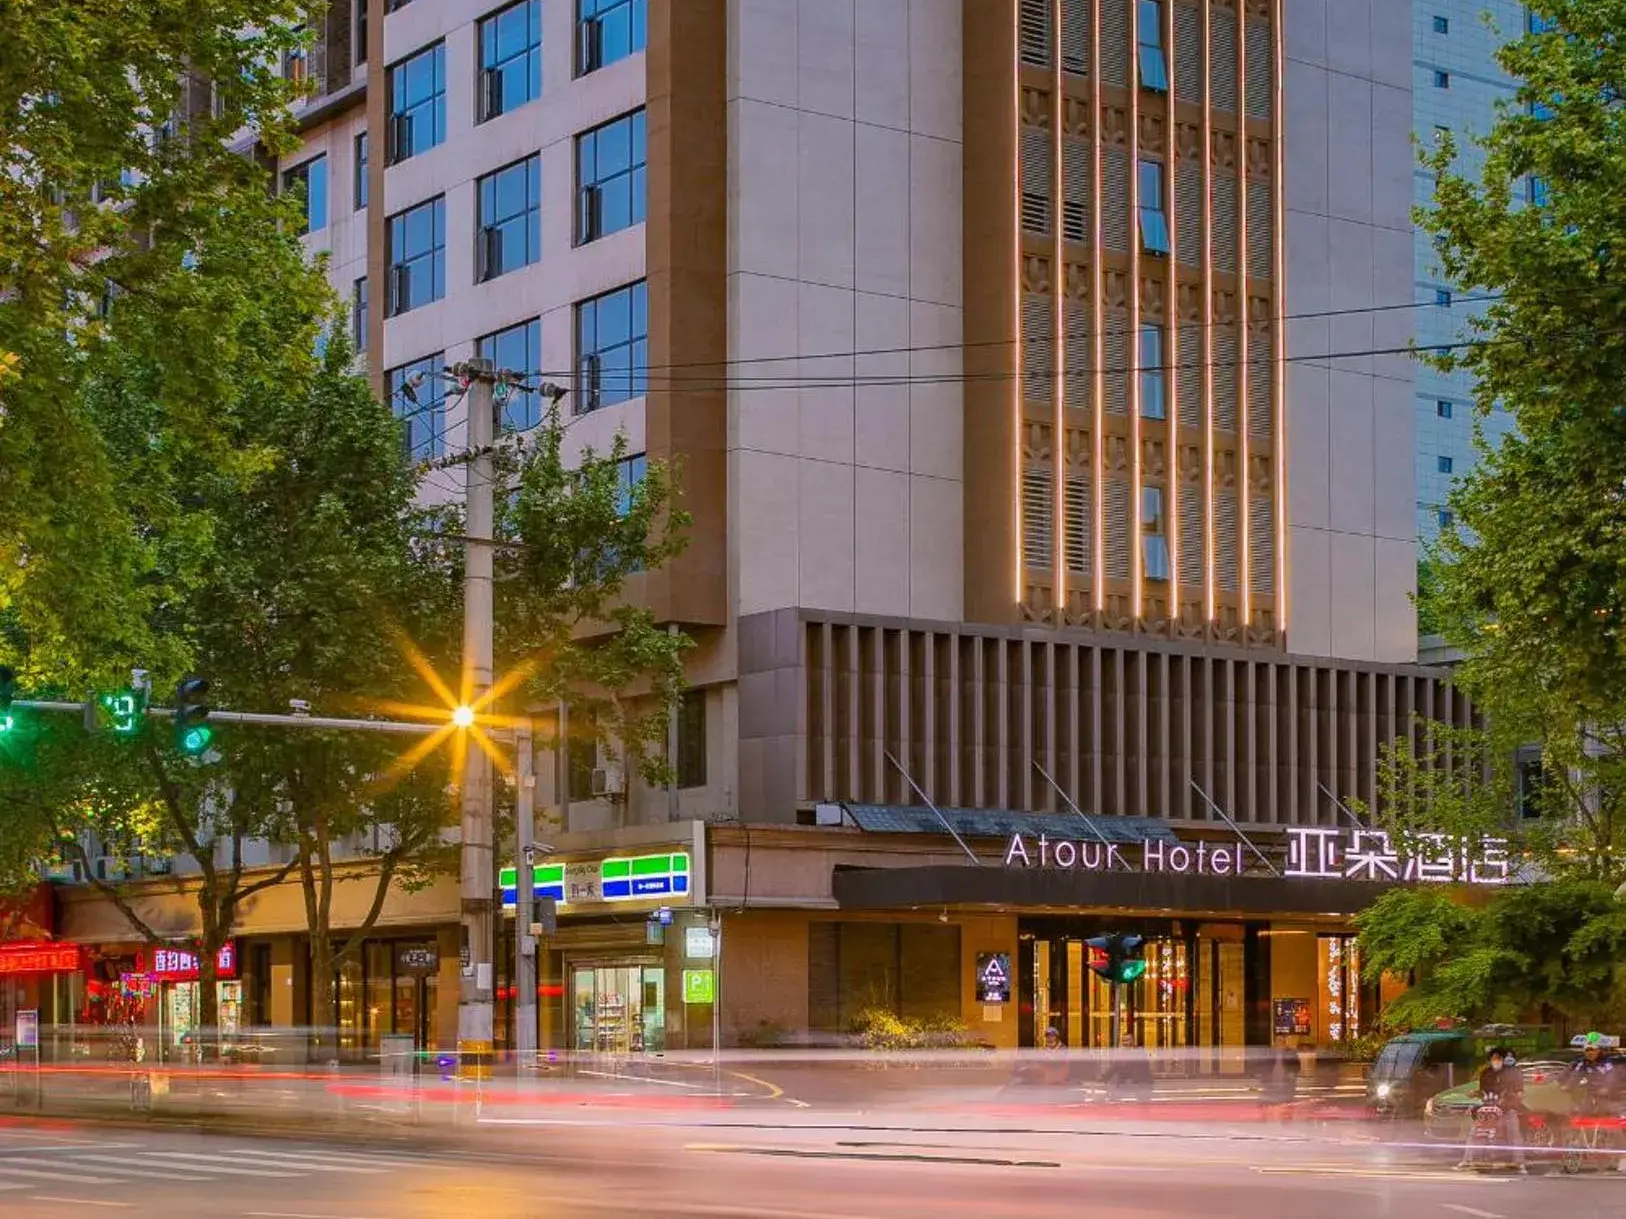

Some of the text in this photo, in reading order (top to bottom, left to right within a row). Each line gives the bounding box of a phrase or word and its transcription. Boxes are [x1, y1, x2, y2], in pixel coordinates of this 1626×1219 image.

[1006, 833, 1242, 873] Atour Hotel
[1284, 828, 1508, 883] 亚朵酒店
